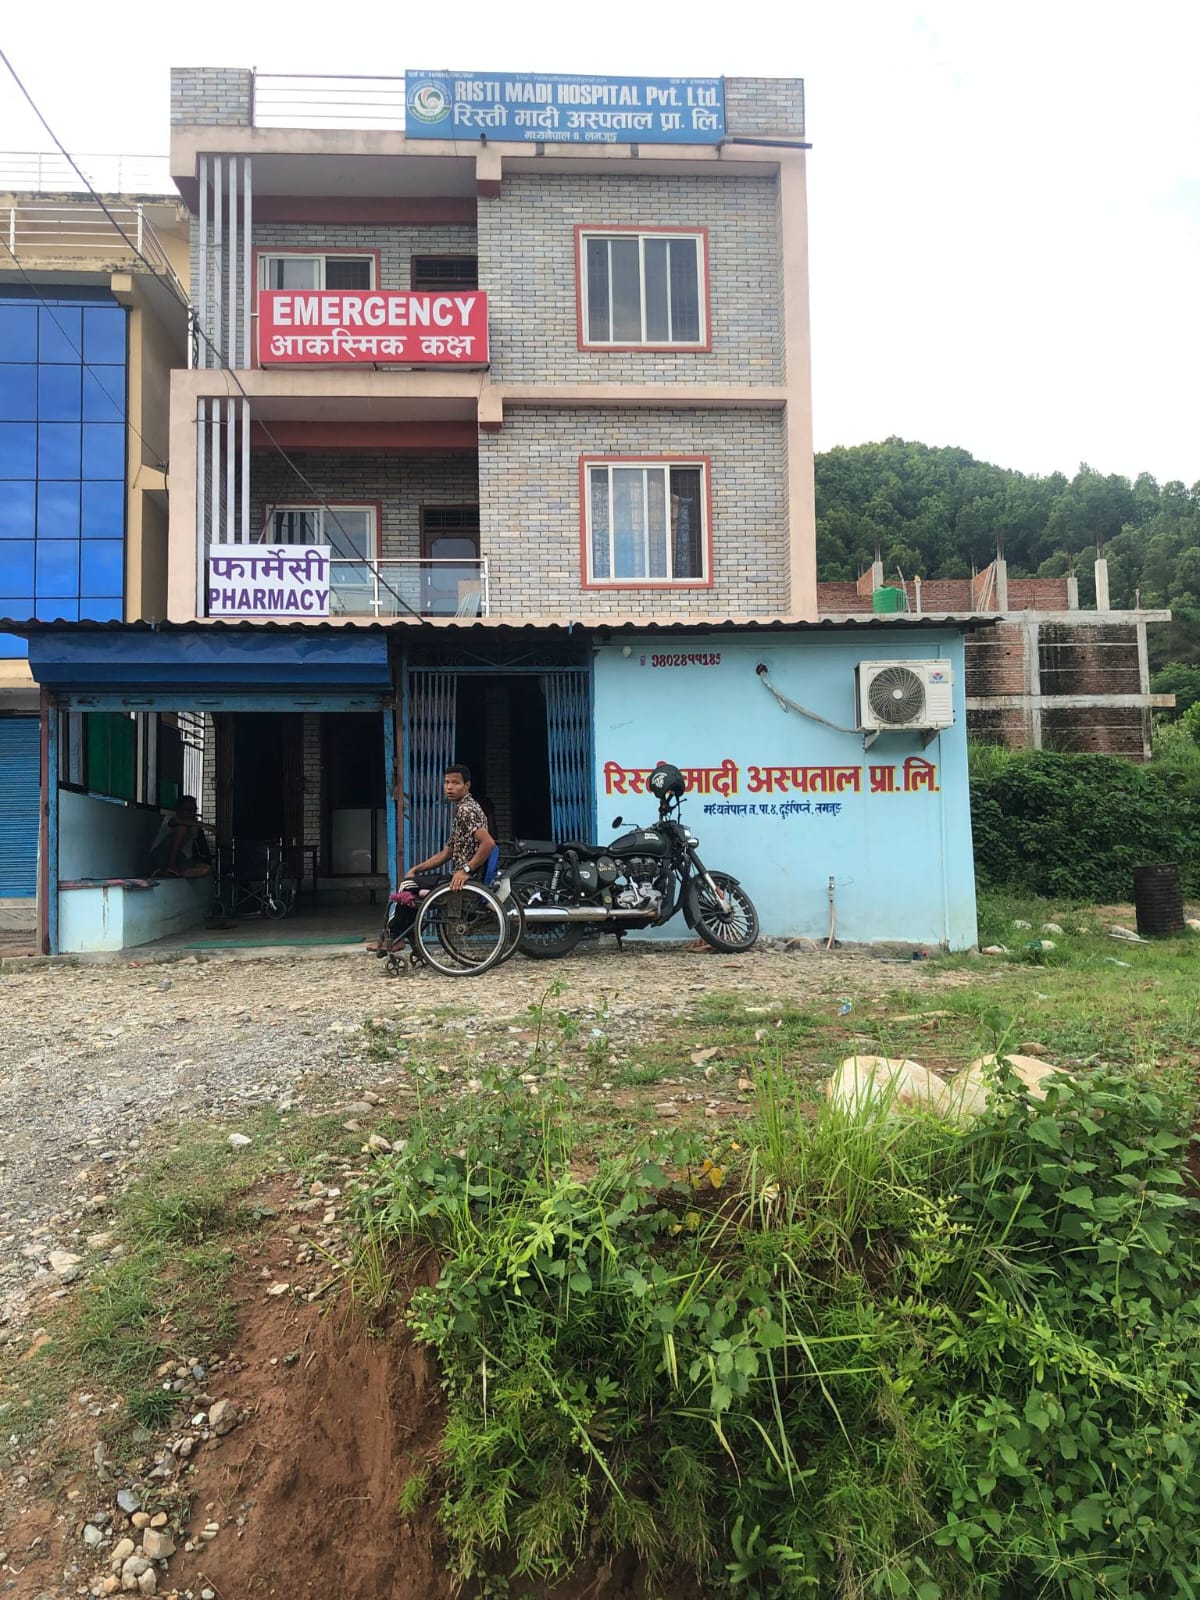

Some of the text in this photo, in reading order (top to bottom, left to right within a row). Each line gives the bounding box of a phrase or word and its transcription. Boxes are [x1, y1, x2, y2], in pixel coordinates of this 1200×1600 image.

[454, 80, 500, 102] RISTI
[505, 82, 553, 104] MADI
[557, 83, 642, 106] HOSPITAL
[646, 85, 683, 106] Pvt.
[687, 86, 721, 107] Ltd.
[453, 102, 508, 127] रिस्ती
[514, 105, 560, 129] मादी
[566, 110, 653, 130] अस्पताल
[272, 295, 476, 326] EMERGENCY
[270, 328, 475, 358] आकस्मिक कक्ष
[209, 548, 329, 584] फार्मेसी
[208, 588, 329, 610] PHARMACY
[747, 765, 862, 793] अस्पताल
